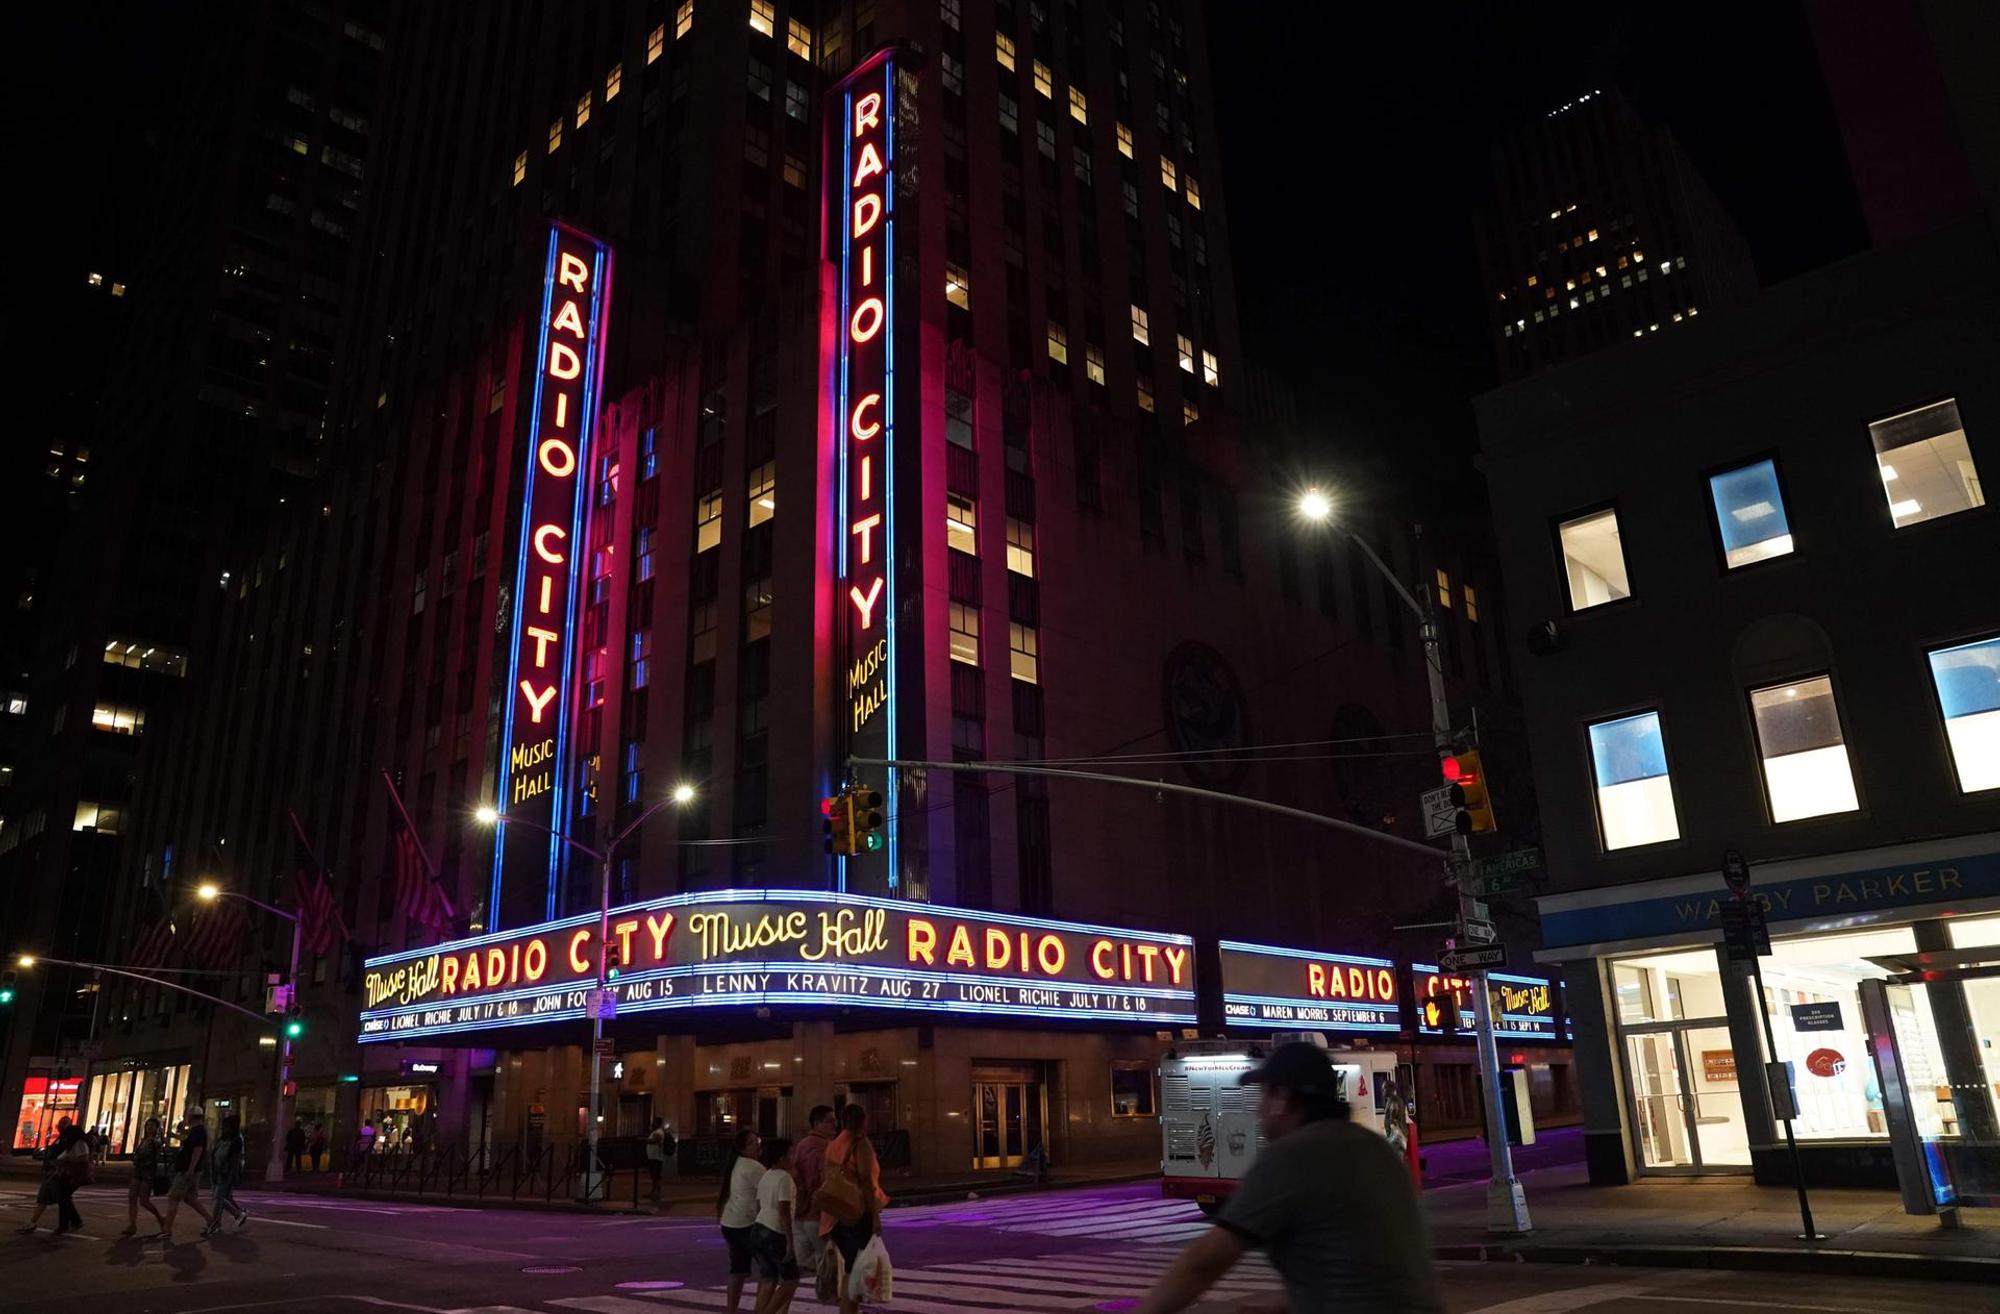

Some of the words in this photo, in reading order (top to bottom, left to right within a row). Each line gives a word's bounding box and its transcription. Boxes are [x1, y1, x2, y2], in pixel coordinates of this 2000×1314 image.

[850, 92, 884, 344] RADIO
[539, 251, 589, 479] RADIO
[849, 393, 884, 631] CITY
[519, 523, 567, 724] CITY
[849, 639, 887, 699] MUSIC
[854, 680, 888, 733] HALL
[511, 739, 554, 774] MUSIC
[514, 771, 551, 804] HALL
[1676, 888, 1792, 921] WABY
[1814, 868, 1963, 905] PARKER
[366, 968, 405, 1009] Music
[399, 954, 440, 1005] Hall
[442, 938, 548, 996] RADIO
[568, 912, 676, 975] CTY
[689, 910, 807, 961] Music
[800, 908, 889, 962] Hall
[907, 918, 1066, 975] RADIO
[1092, 940, 1187, 984] CITY
[1307, 962, 1394, 1002] RADIO
[1445, 954, 1466, 966] ONE
[1478, 950, 1500, 962] WAY
[391, 1014, 420, 1031] LIONEL
[424, 1008, 452, 1026] RICHIE
[457, 1005, 480, 1023] JULY
[484, 1003, 494, 1019] 17
[508, 1000, 518, 1016] 18
[533, 992, 562, 1015] JOHN
[626, 981, 652, 1001] AUG
[660, 978, 673, 997] 15
[703, 973, 771, 994] LENNY
[787, 973, 869, 995] KRAVITZ
[880, 978, 912, 998] AUG
[922, 981, 941, 999] 27
[960, 983, 1011, 1004] LIONEL
[1019, 987, 1061, 1007] RICHIE
[1069, 992, 1099, 1010] JULY
[1106, 994, 1117, 1011] 17
[1135, 997, 1147, 1012] 18
[1225, 1004, 1250, 1016] CHASE
[1262, 1005, 1294, 1020] MAREN
[1297, 1007, 1329, 1022] MORRIS
[1333, 1008, 1377, 1023] SEPTEMBER
[1379, 1011, 1385, 1023] 6
